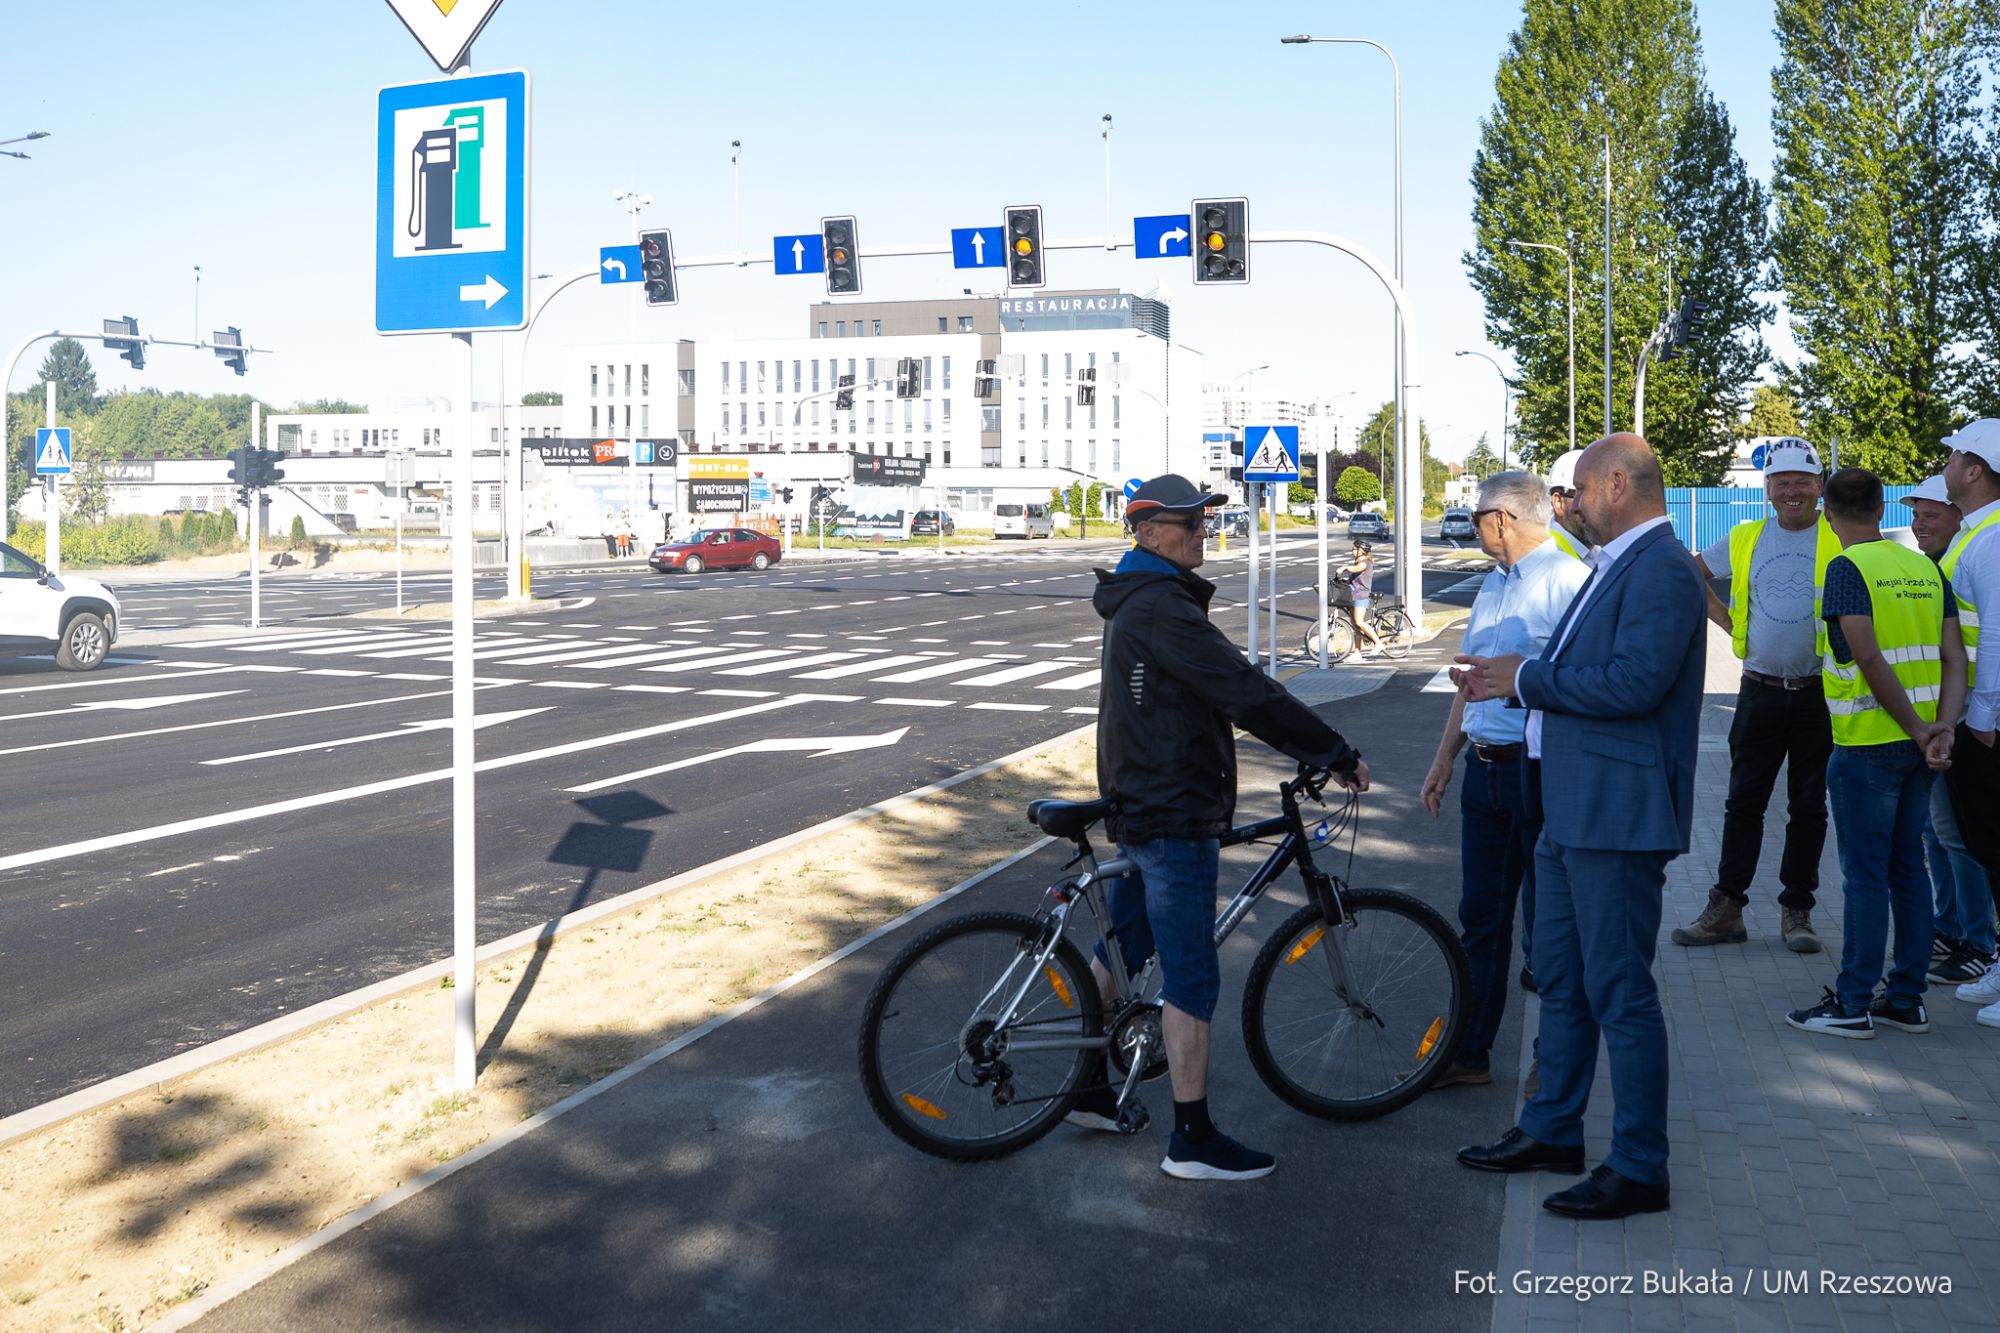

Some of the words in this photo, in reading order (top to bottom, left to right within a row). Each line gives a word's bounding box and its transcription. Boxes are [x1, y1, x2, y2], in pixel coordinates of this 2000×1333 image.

[1001, 297, 1129, 313] RESTAURACJA
[696, 498, 742, 510] SAMOCHODÓW
[1876, 578, 1902, 588] Miejski
[1903, 577, 1925, 588] Zrząd
